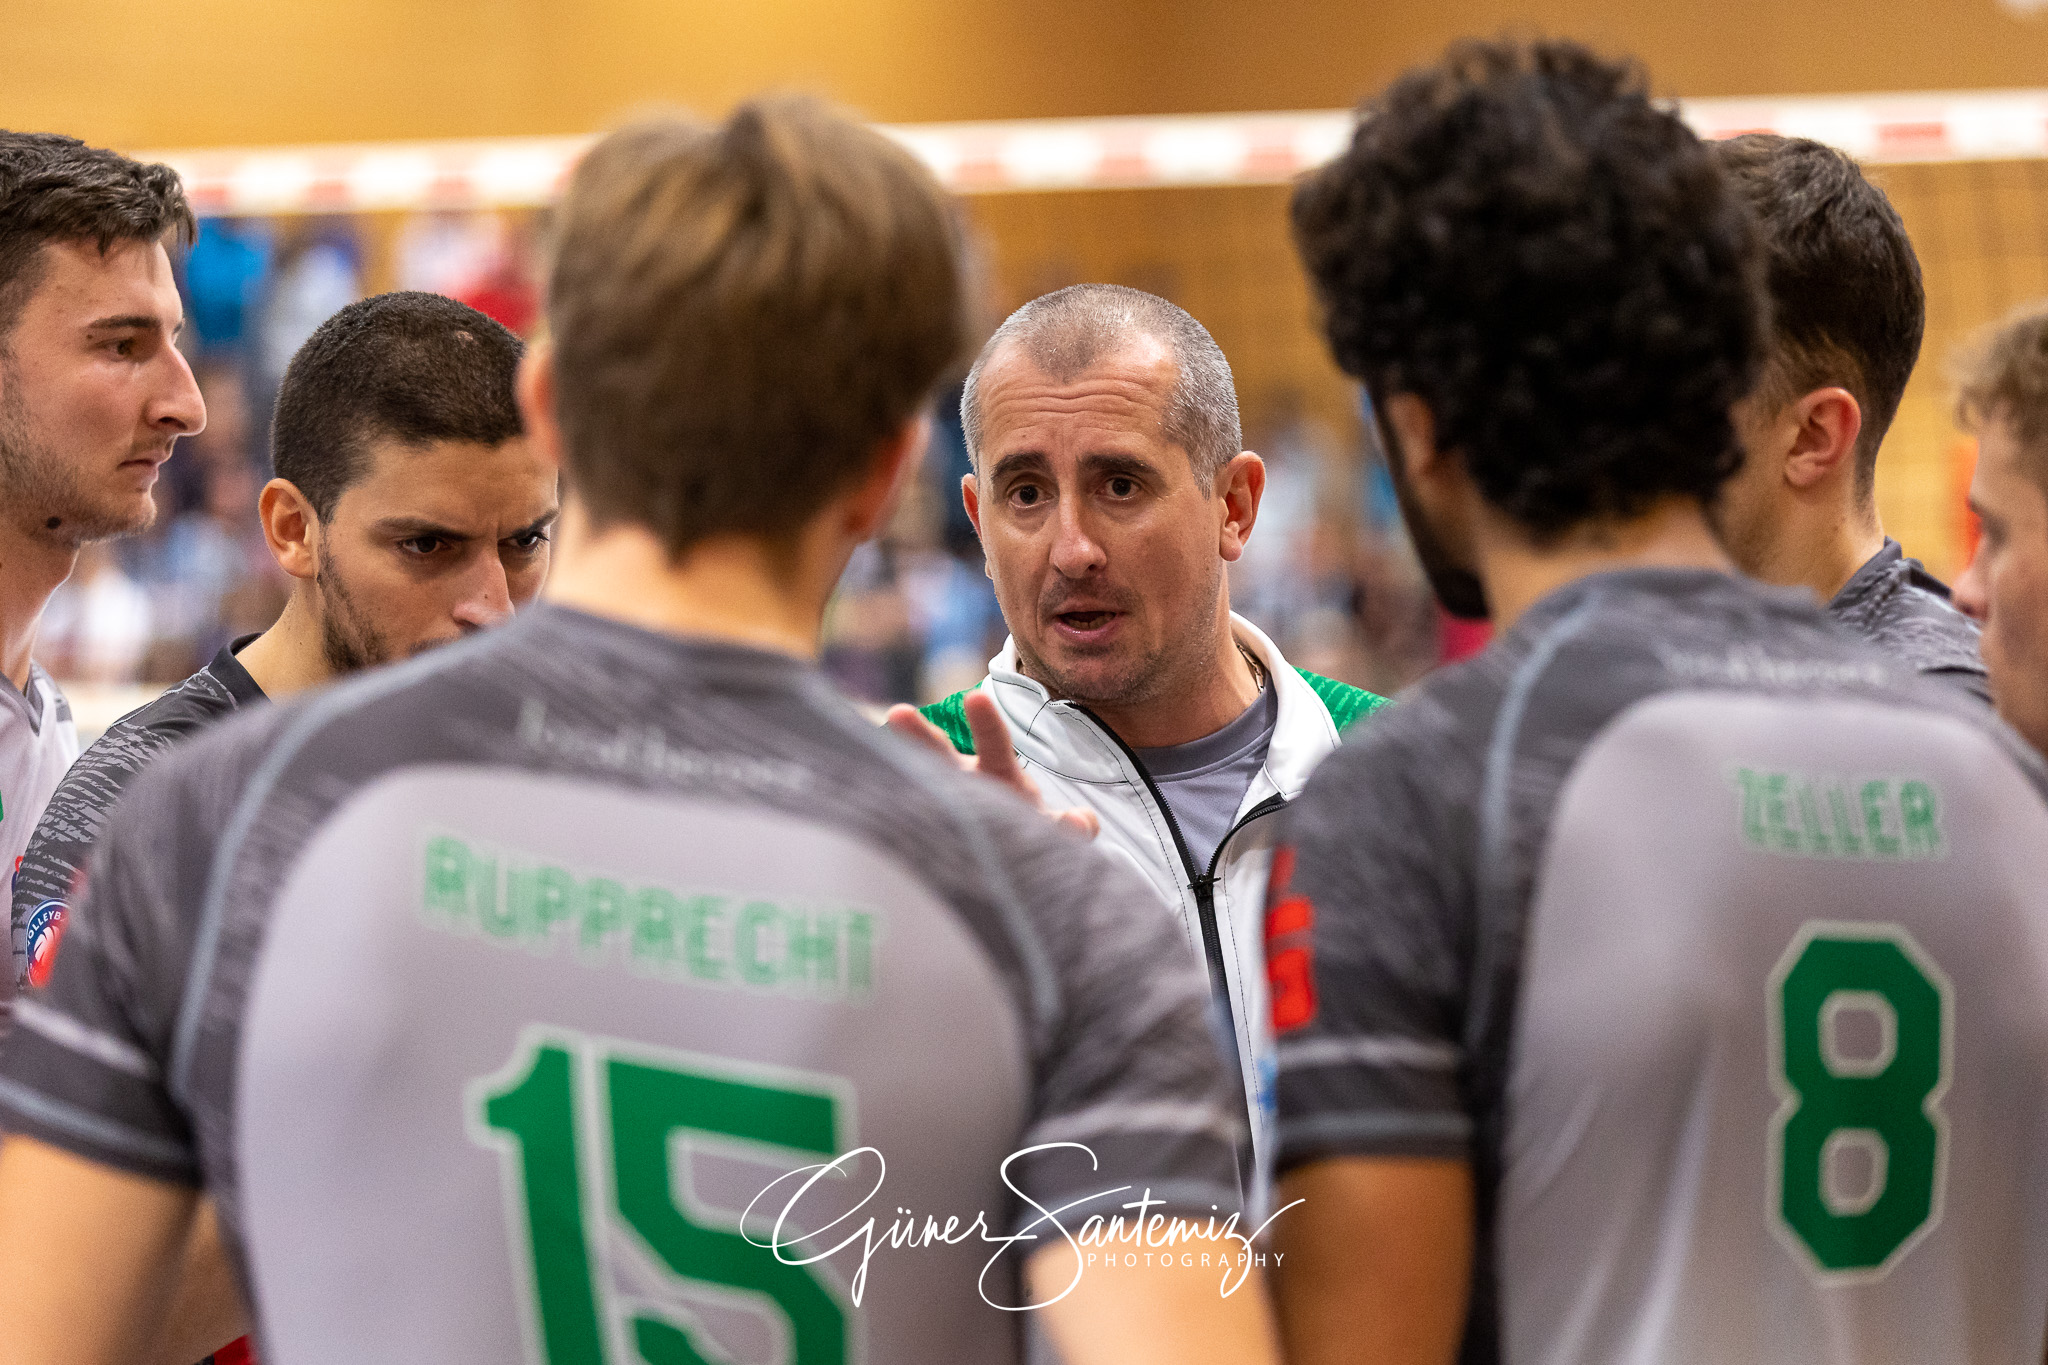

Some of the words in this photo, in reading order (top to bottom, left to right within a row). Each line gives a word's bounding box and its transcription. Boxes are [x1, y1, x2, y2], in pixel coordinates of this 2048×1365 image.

[423, 835, 875, 993] RUPPRECHT
[1735, 766, 1942, 855] ZELLER
[470, 1028, 862, 1365] 15
[1769, 923, 1950, 1284] 8
